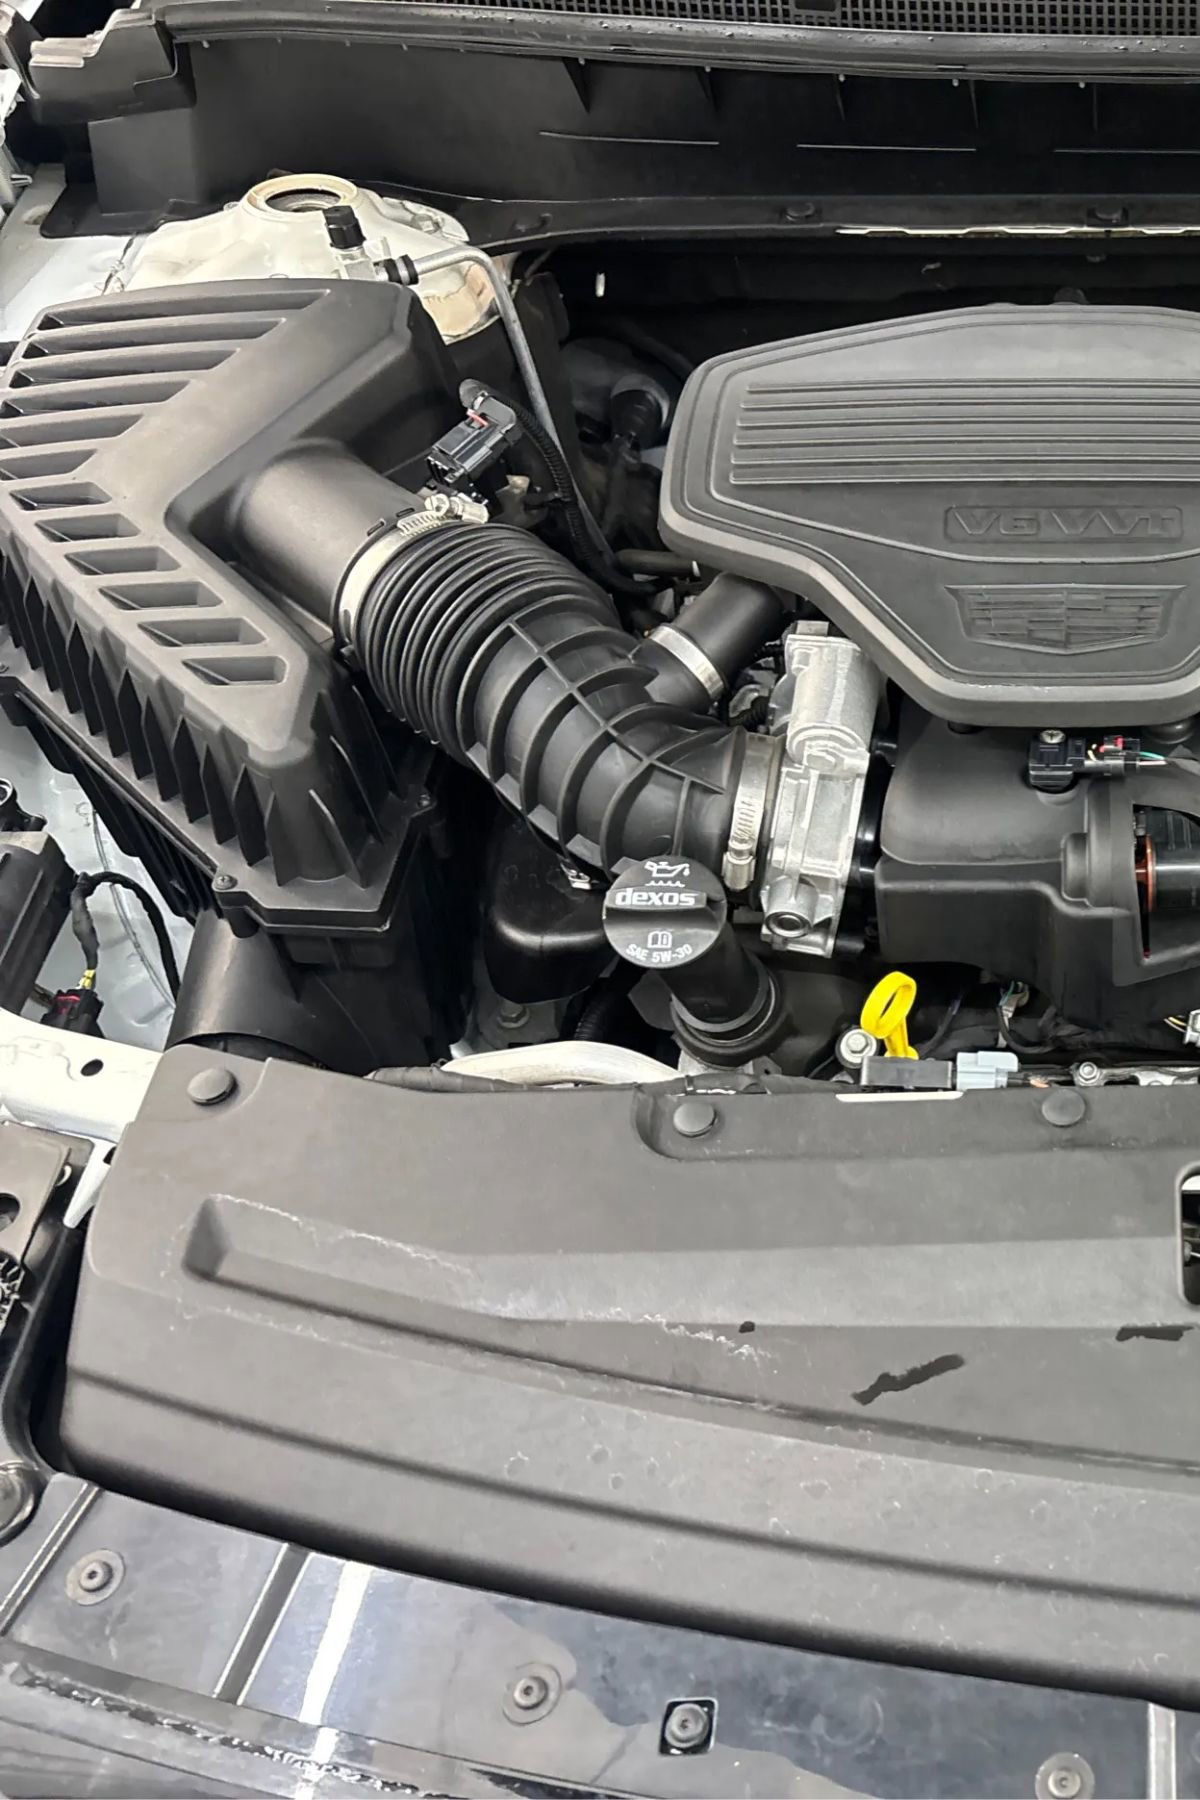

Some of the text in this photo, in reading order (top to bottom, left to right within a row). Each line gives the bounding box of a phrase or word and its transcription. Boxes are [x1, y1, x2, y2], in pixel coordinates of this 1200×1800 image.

[615, 888, 699, 905] dexos
[626, 943, 693, 963] SAE 5W-30
